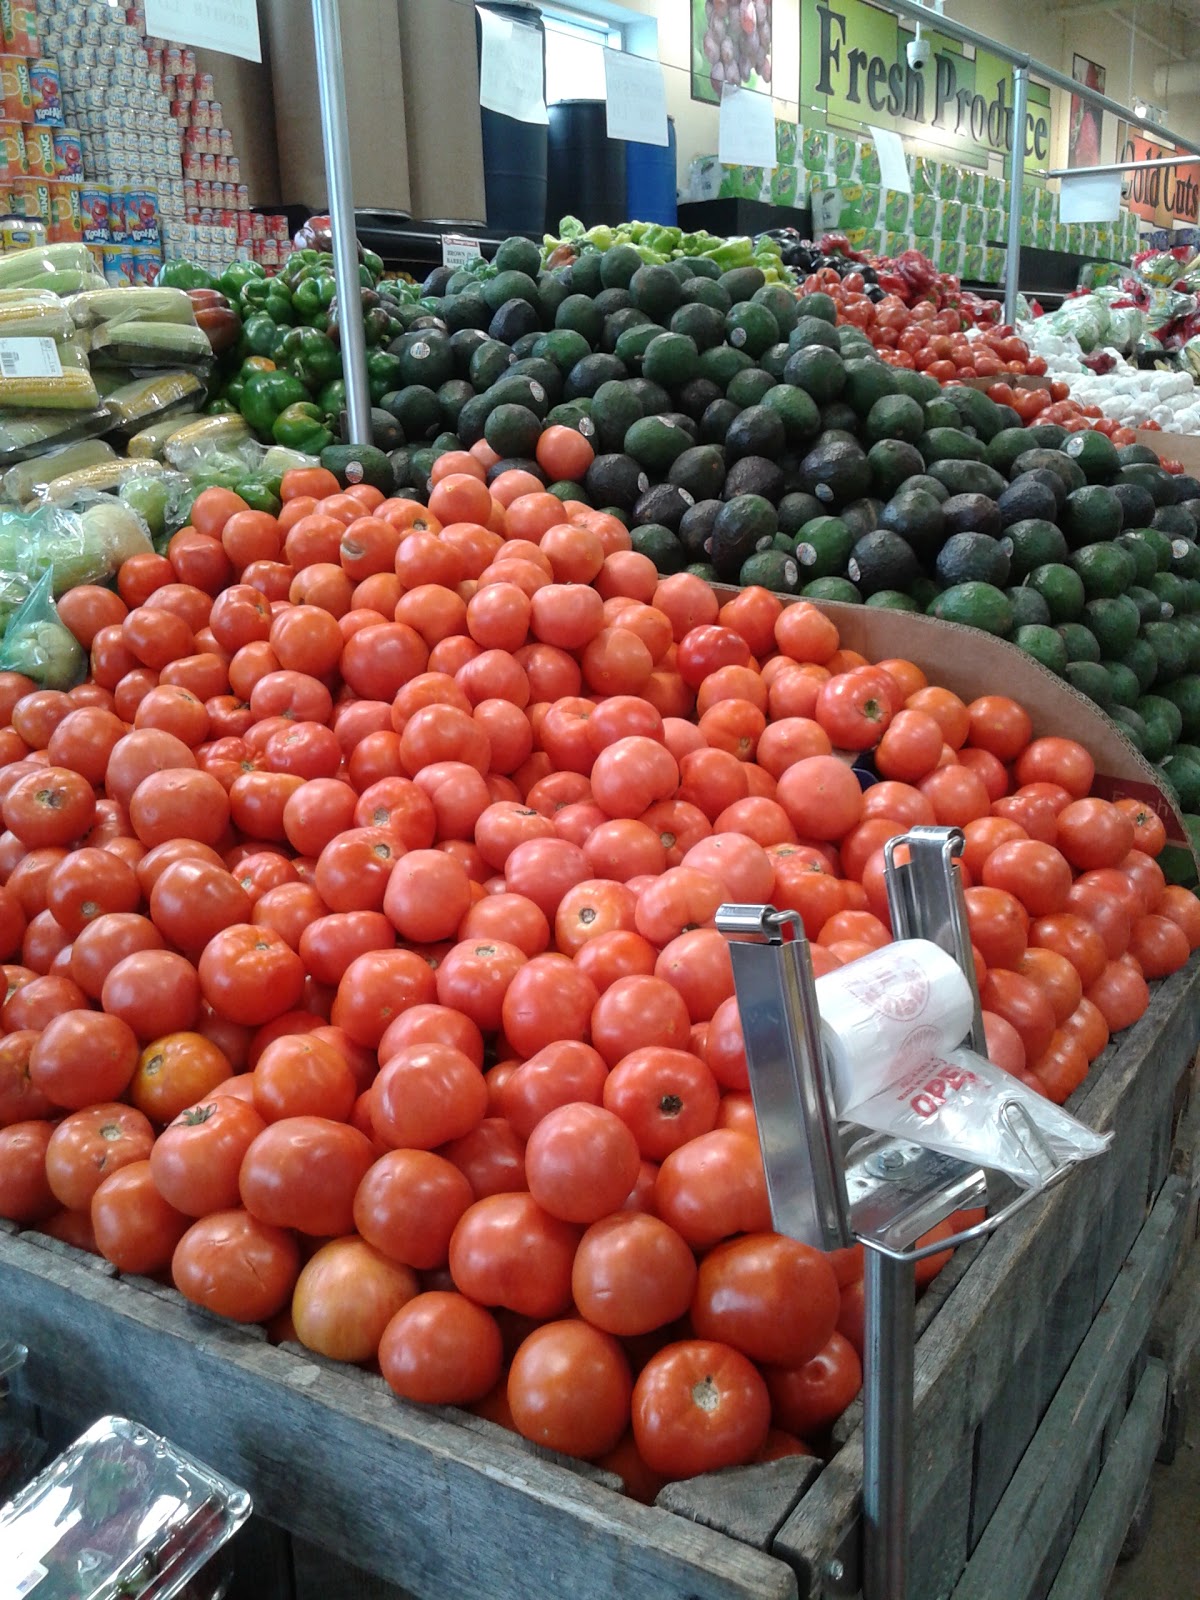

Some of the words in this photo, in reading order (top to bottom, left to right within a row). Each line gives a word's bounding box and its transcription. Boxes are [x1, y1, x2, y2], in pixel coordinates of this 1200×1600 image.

[17, 64, 28, 95] TANG
[814, 4, 925, 123] Fresh
[38, 133, 51, 161] TANG
[1120, 140, 1163, 208] Cold
[1164, 163, 1199, 218] Cuts
[38, 186, 49, 217] TANG
[910, 1066, 978, 1118] OPE
